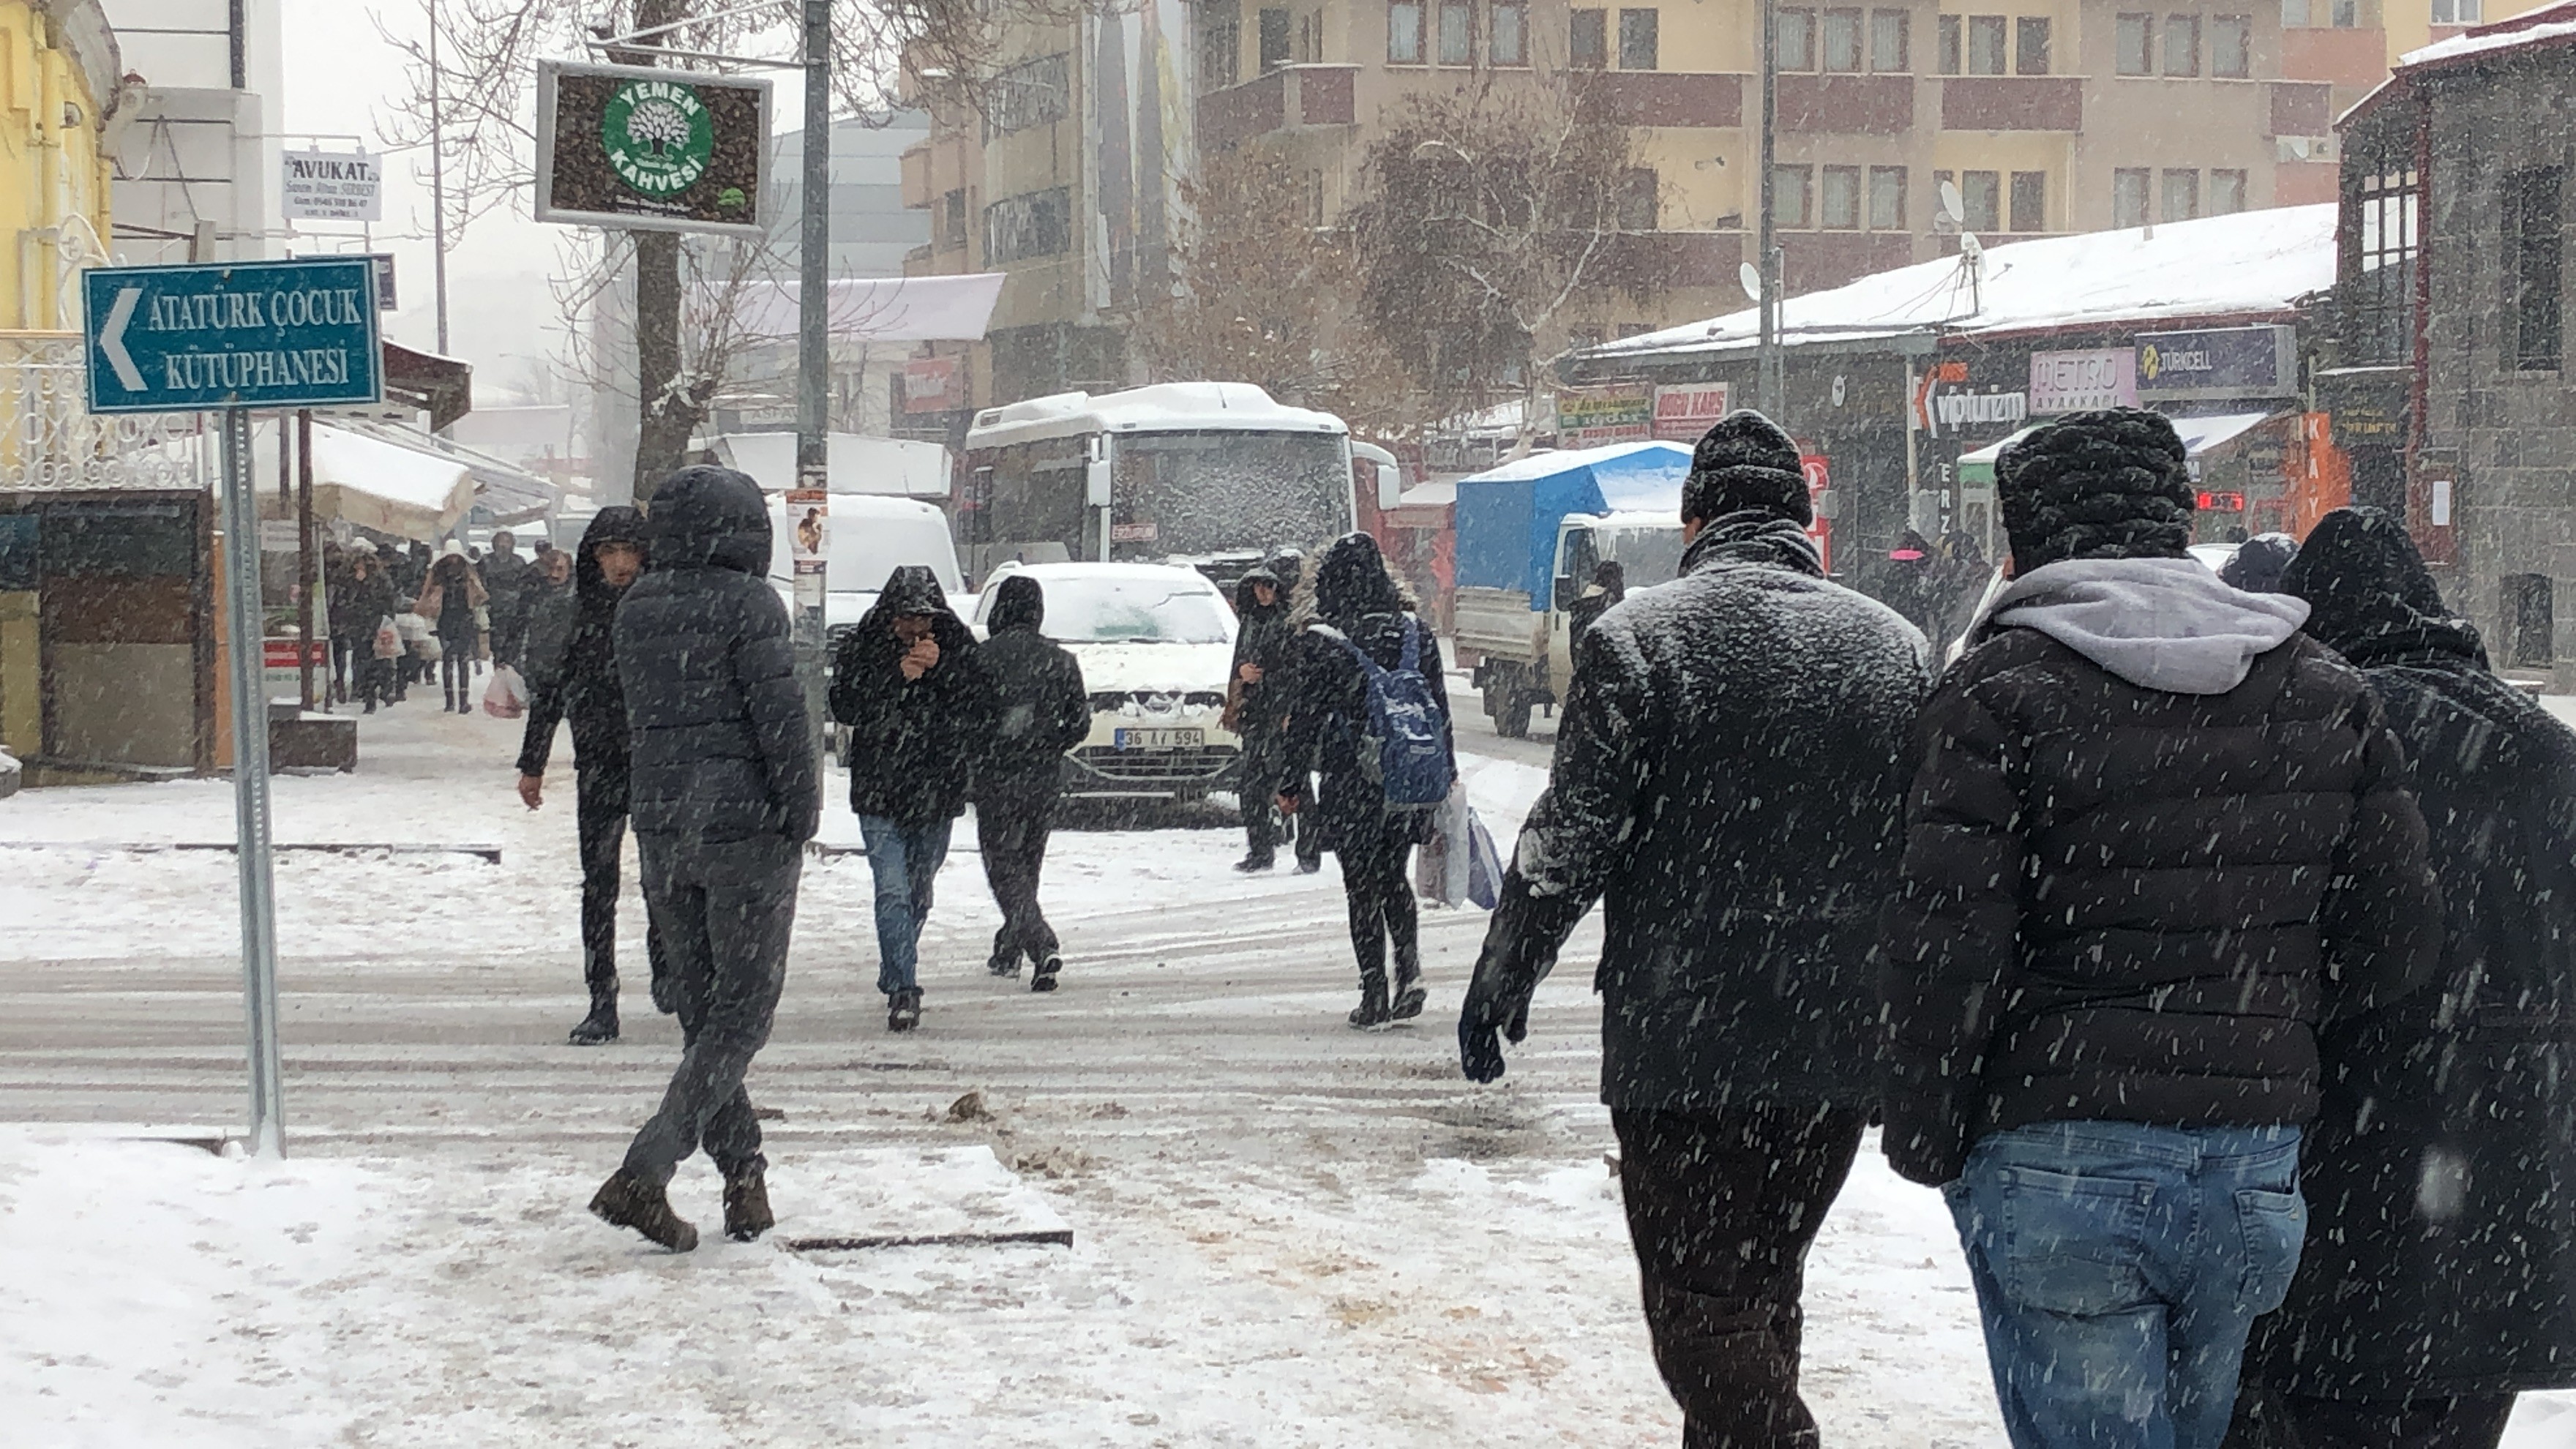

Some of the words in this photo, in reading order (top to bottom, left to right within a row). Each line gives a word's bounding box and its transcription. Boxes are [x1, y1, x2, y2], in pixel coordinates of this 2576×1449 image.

[620, 81, 700, 116] YEMEN
[293, 160, 369, 181] AVUKAT
[610, 148, 703, 191] KAHVESİ
[149, 284, 266, 331] ATATÜRK
[270, 288, 362, 337] ÇOCUK
[165, 338, 350, 389] KÜTÜPHANESİ
[2034, 358, 2119, 393] METRO
[1126, 732, 1142, 746] 36
